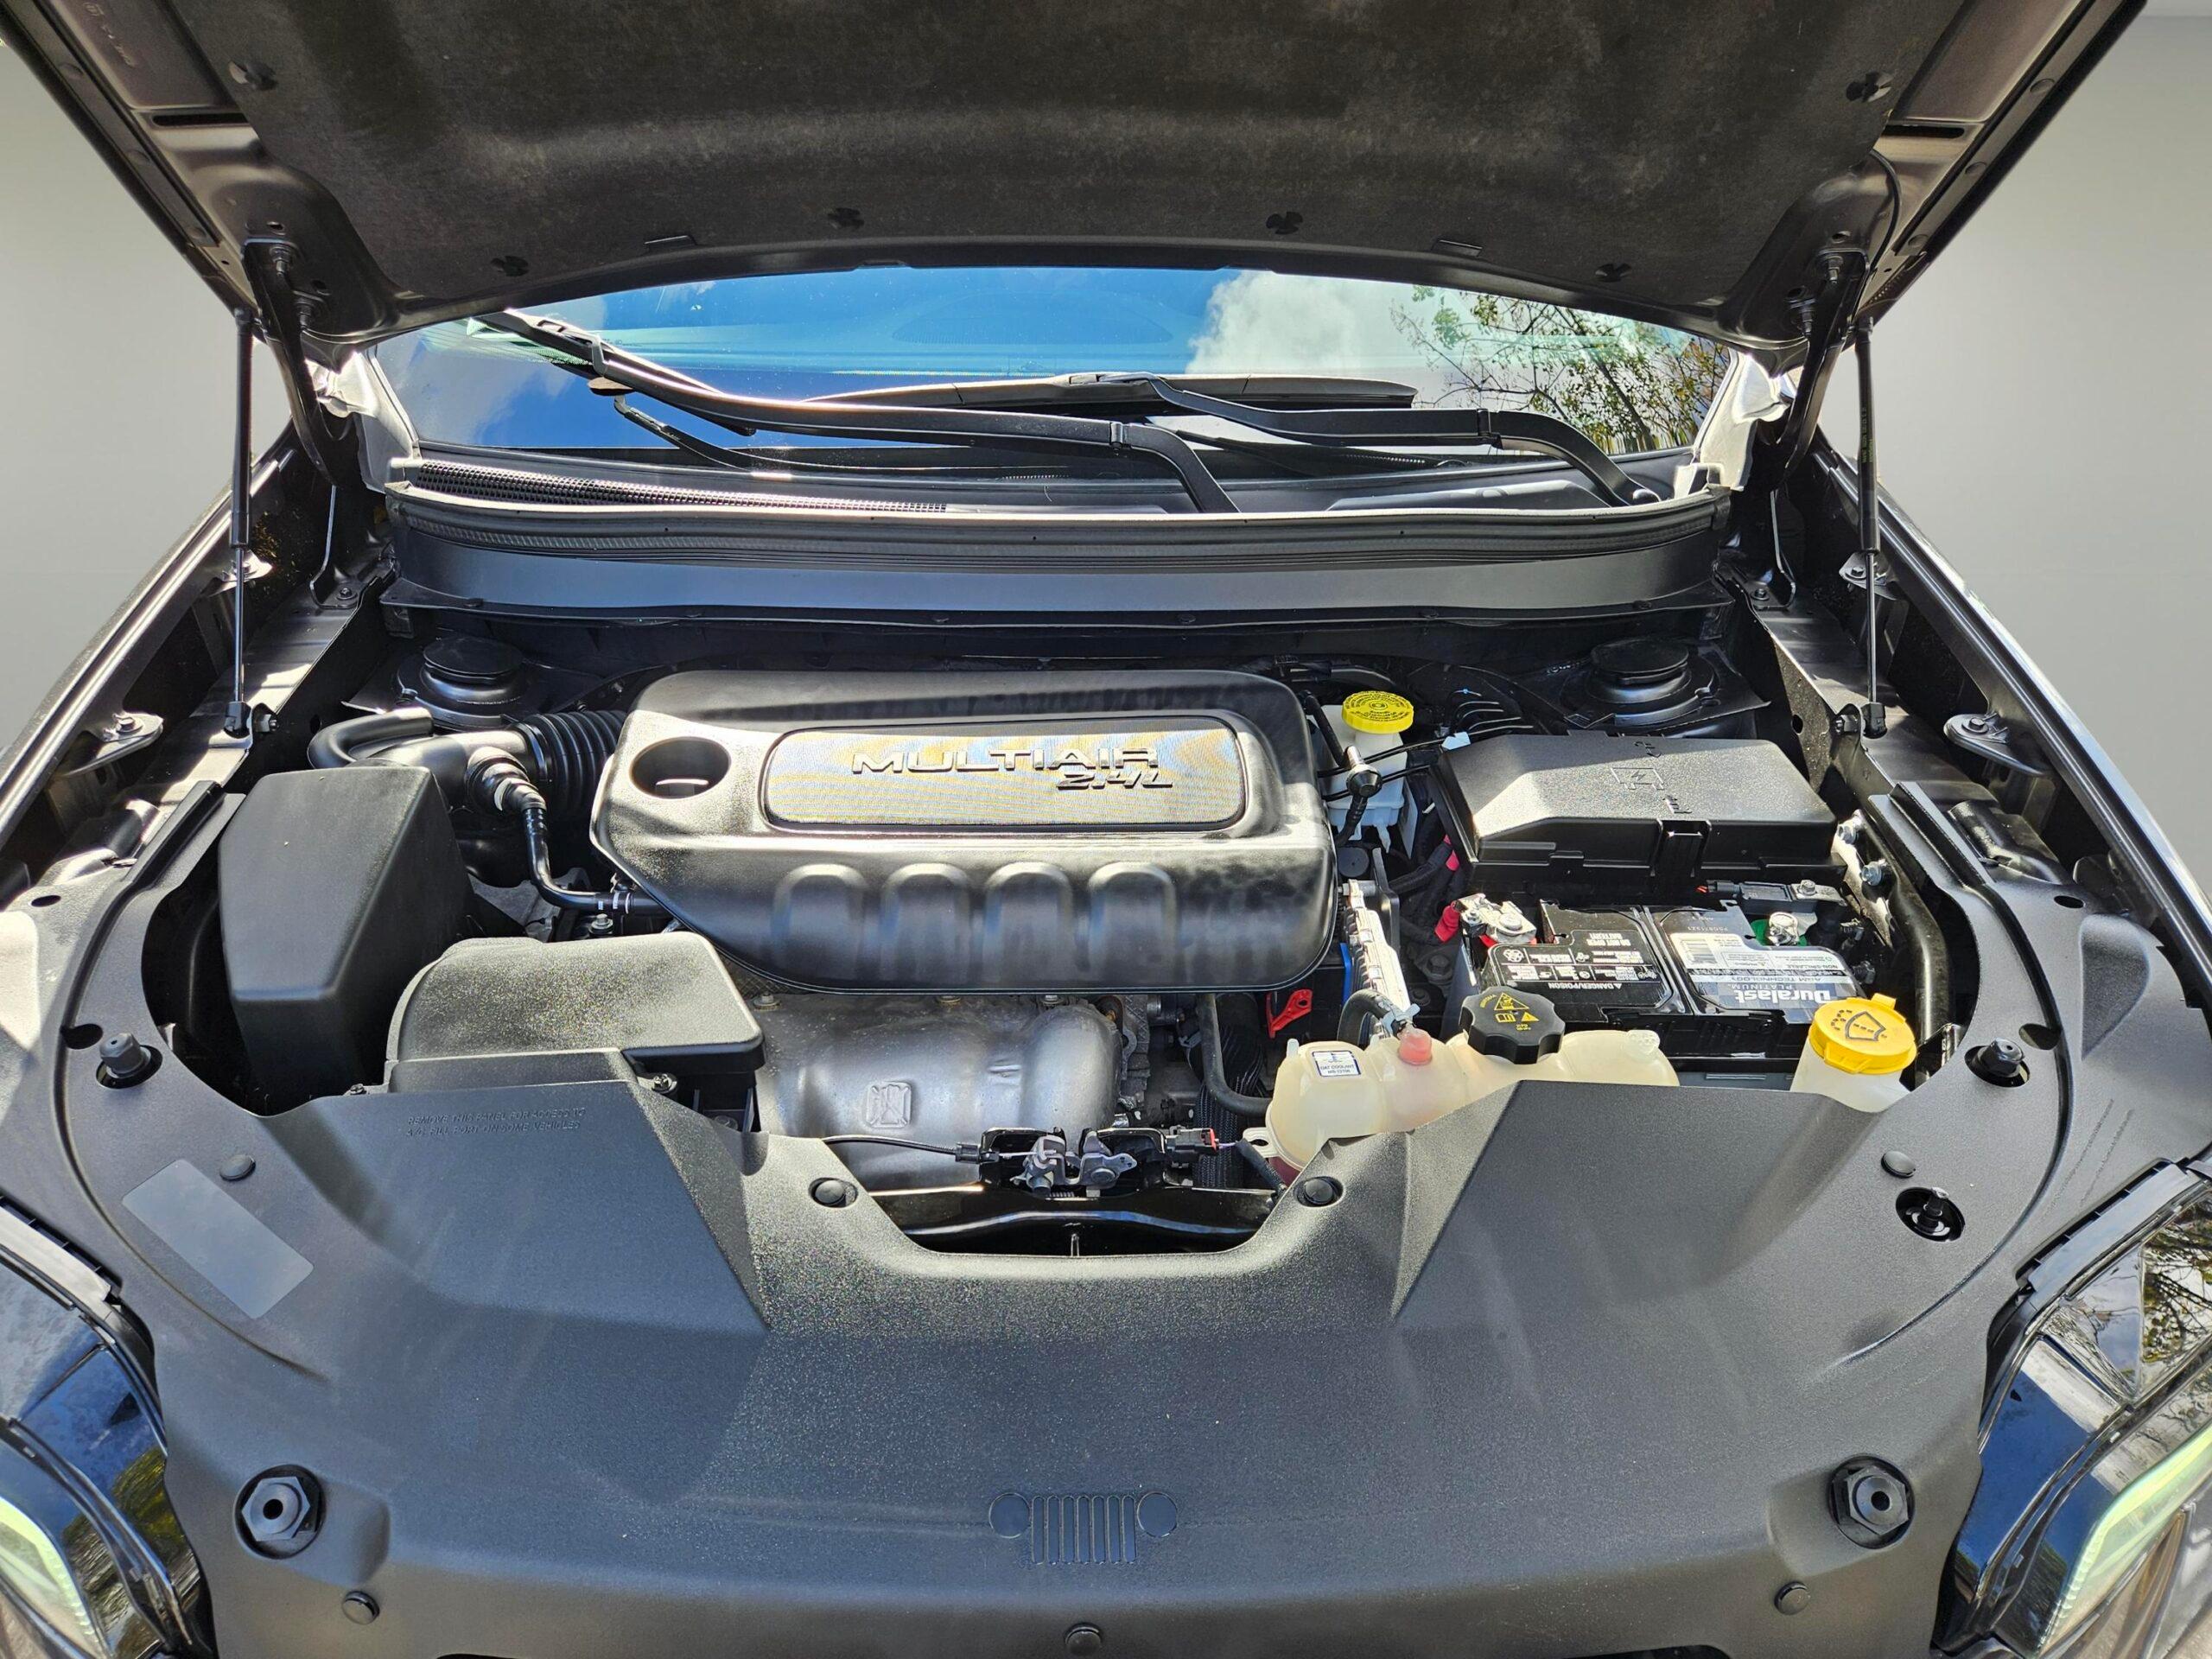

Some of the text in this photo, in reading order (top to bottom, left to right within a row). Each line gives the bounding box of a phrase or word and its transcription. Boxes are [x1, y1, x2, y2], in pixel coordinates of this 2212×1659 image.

[852, 747, 1159, 774] MULTIAIR
[1056, 769, 1173, 790] 2.4L
[1733, 989, 1831, 1003] Duralast
